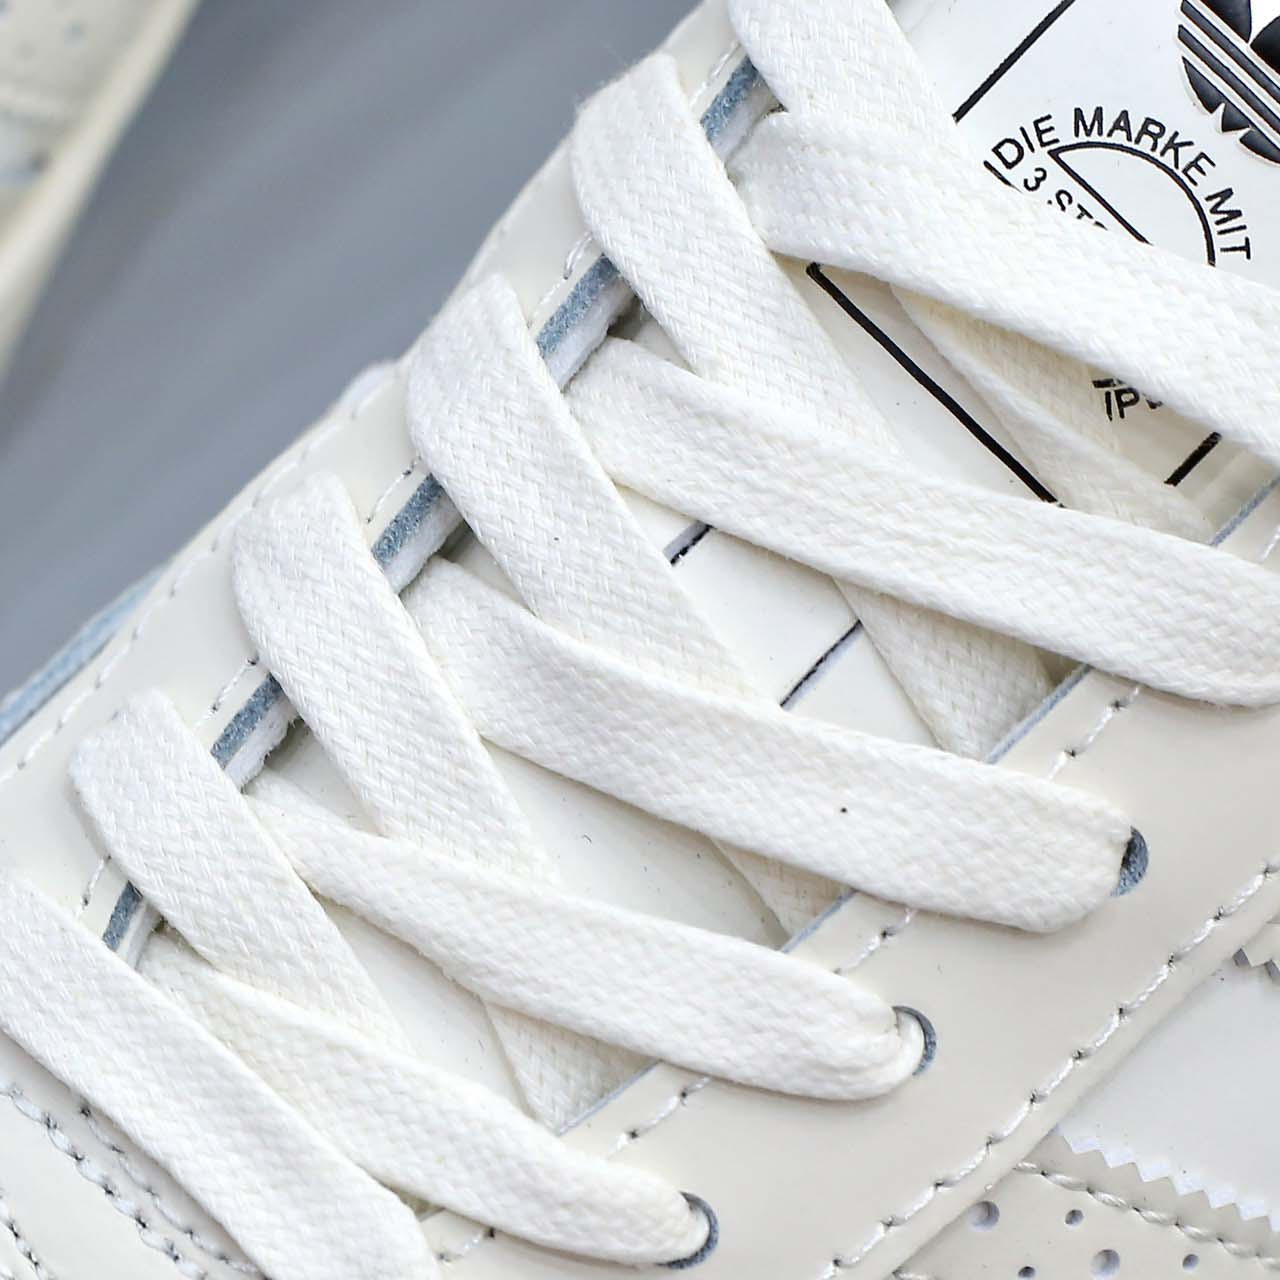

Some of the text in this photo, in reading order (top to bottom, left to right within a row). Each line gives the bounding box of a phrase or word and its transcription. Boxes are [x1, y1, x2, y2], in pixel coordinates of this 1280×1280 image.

[992, 106, 1251, 260] DIE MARKE MIT
[1024, 167, 1047, 192] 3
